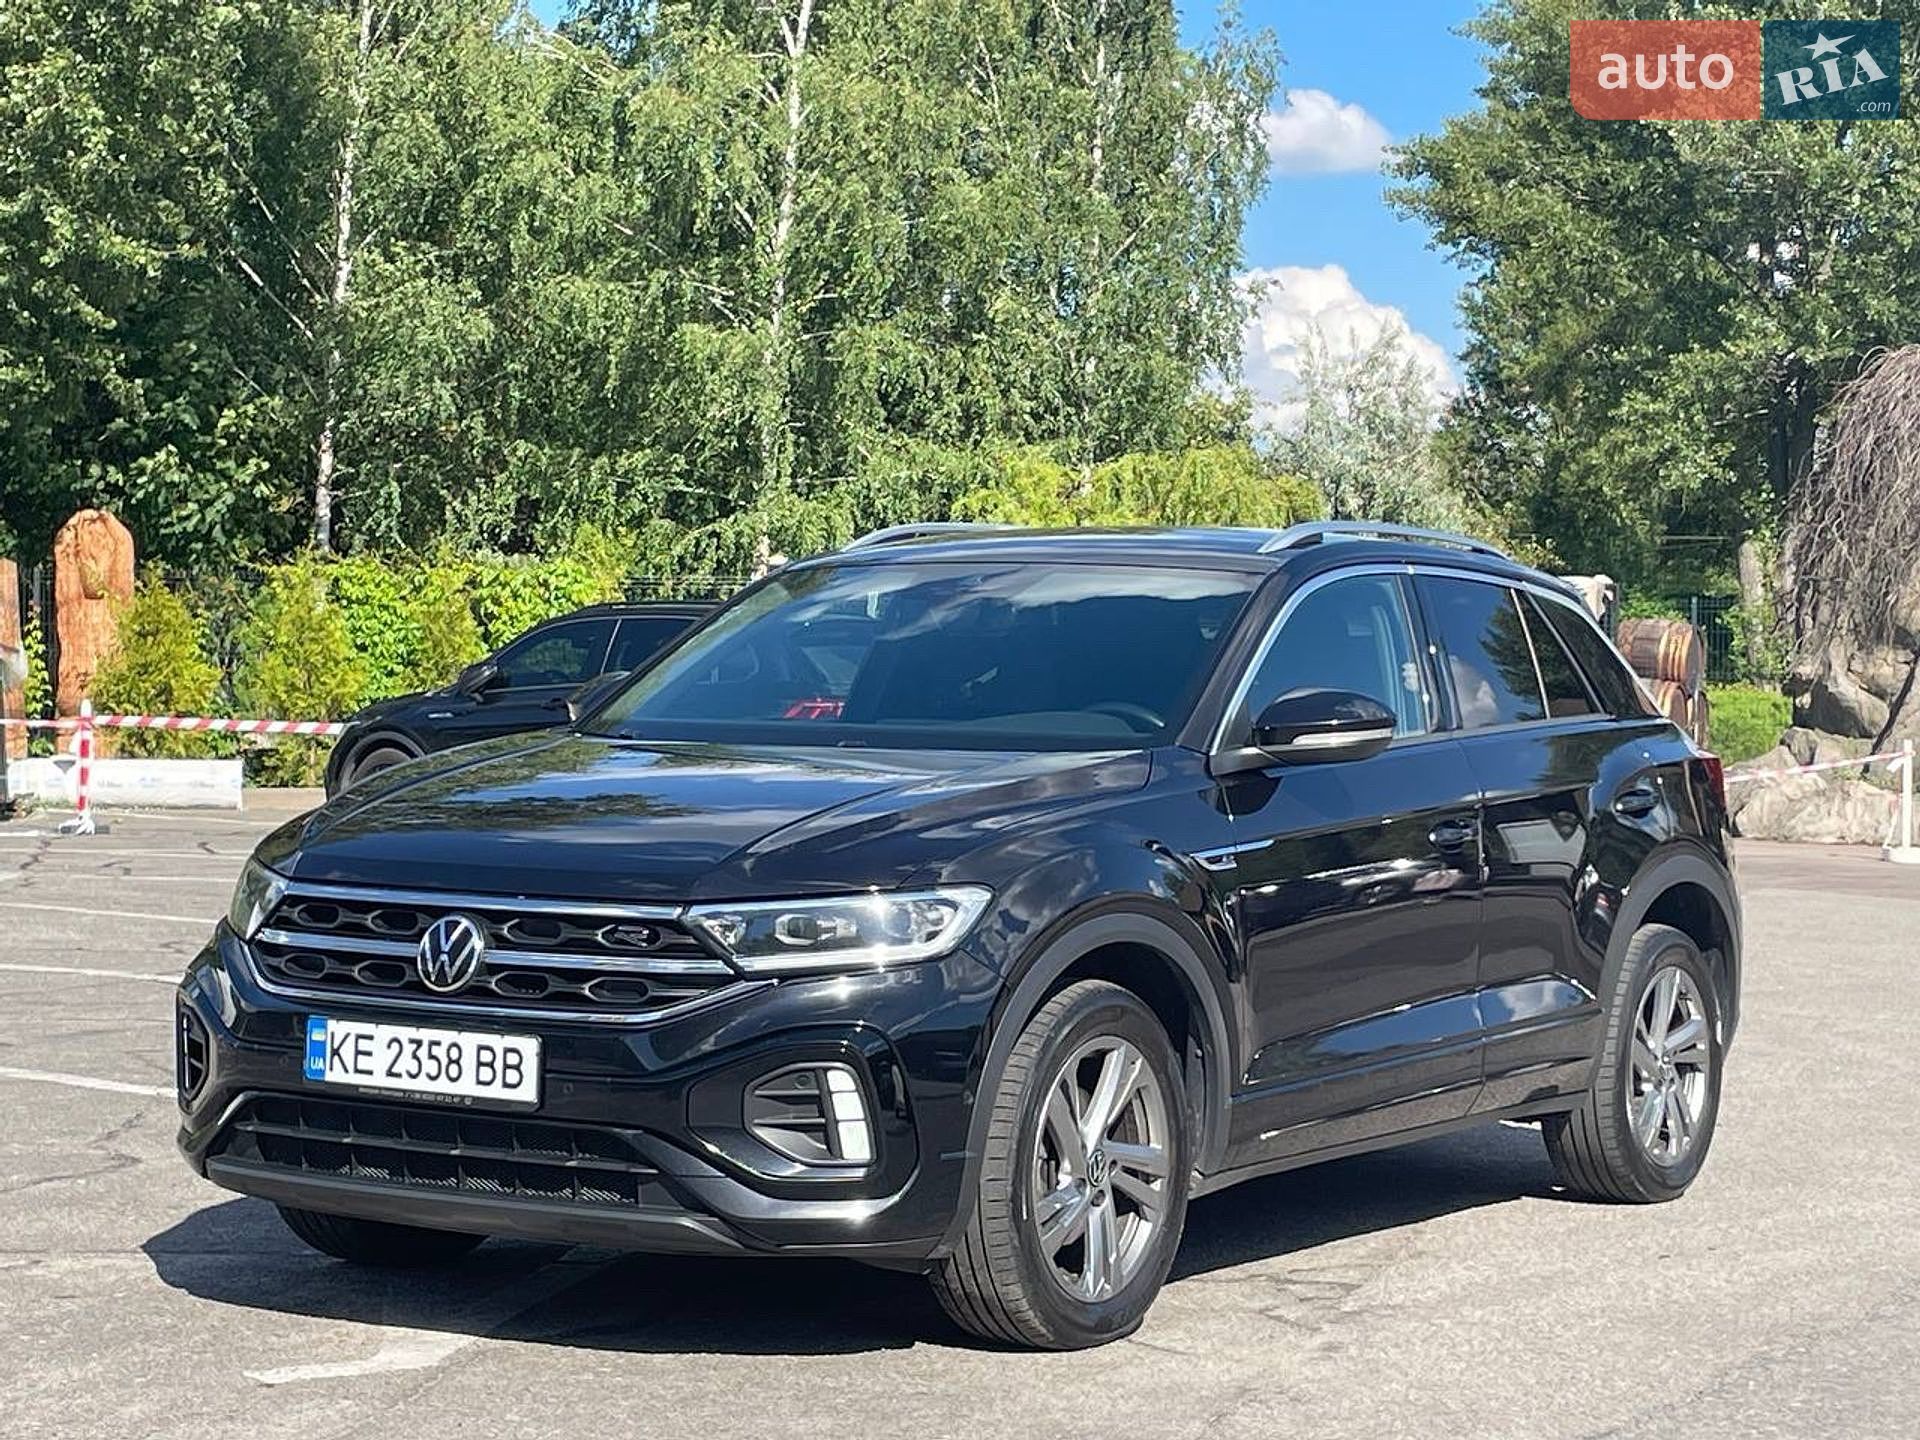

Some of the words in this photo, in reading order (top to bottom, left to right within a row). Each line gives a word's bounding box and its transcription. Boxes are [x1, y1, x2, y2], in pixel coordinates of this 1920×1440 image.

[310, 1055, 326, 1072] UA
[329, 1031, 374, 1076] KE
[386, 1036, 463, 1083] 2358
[475, 1043, 524, 1089] BB
